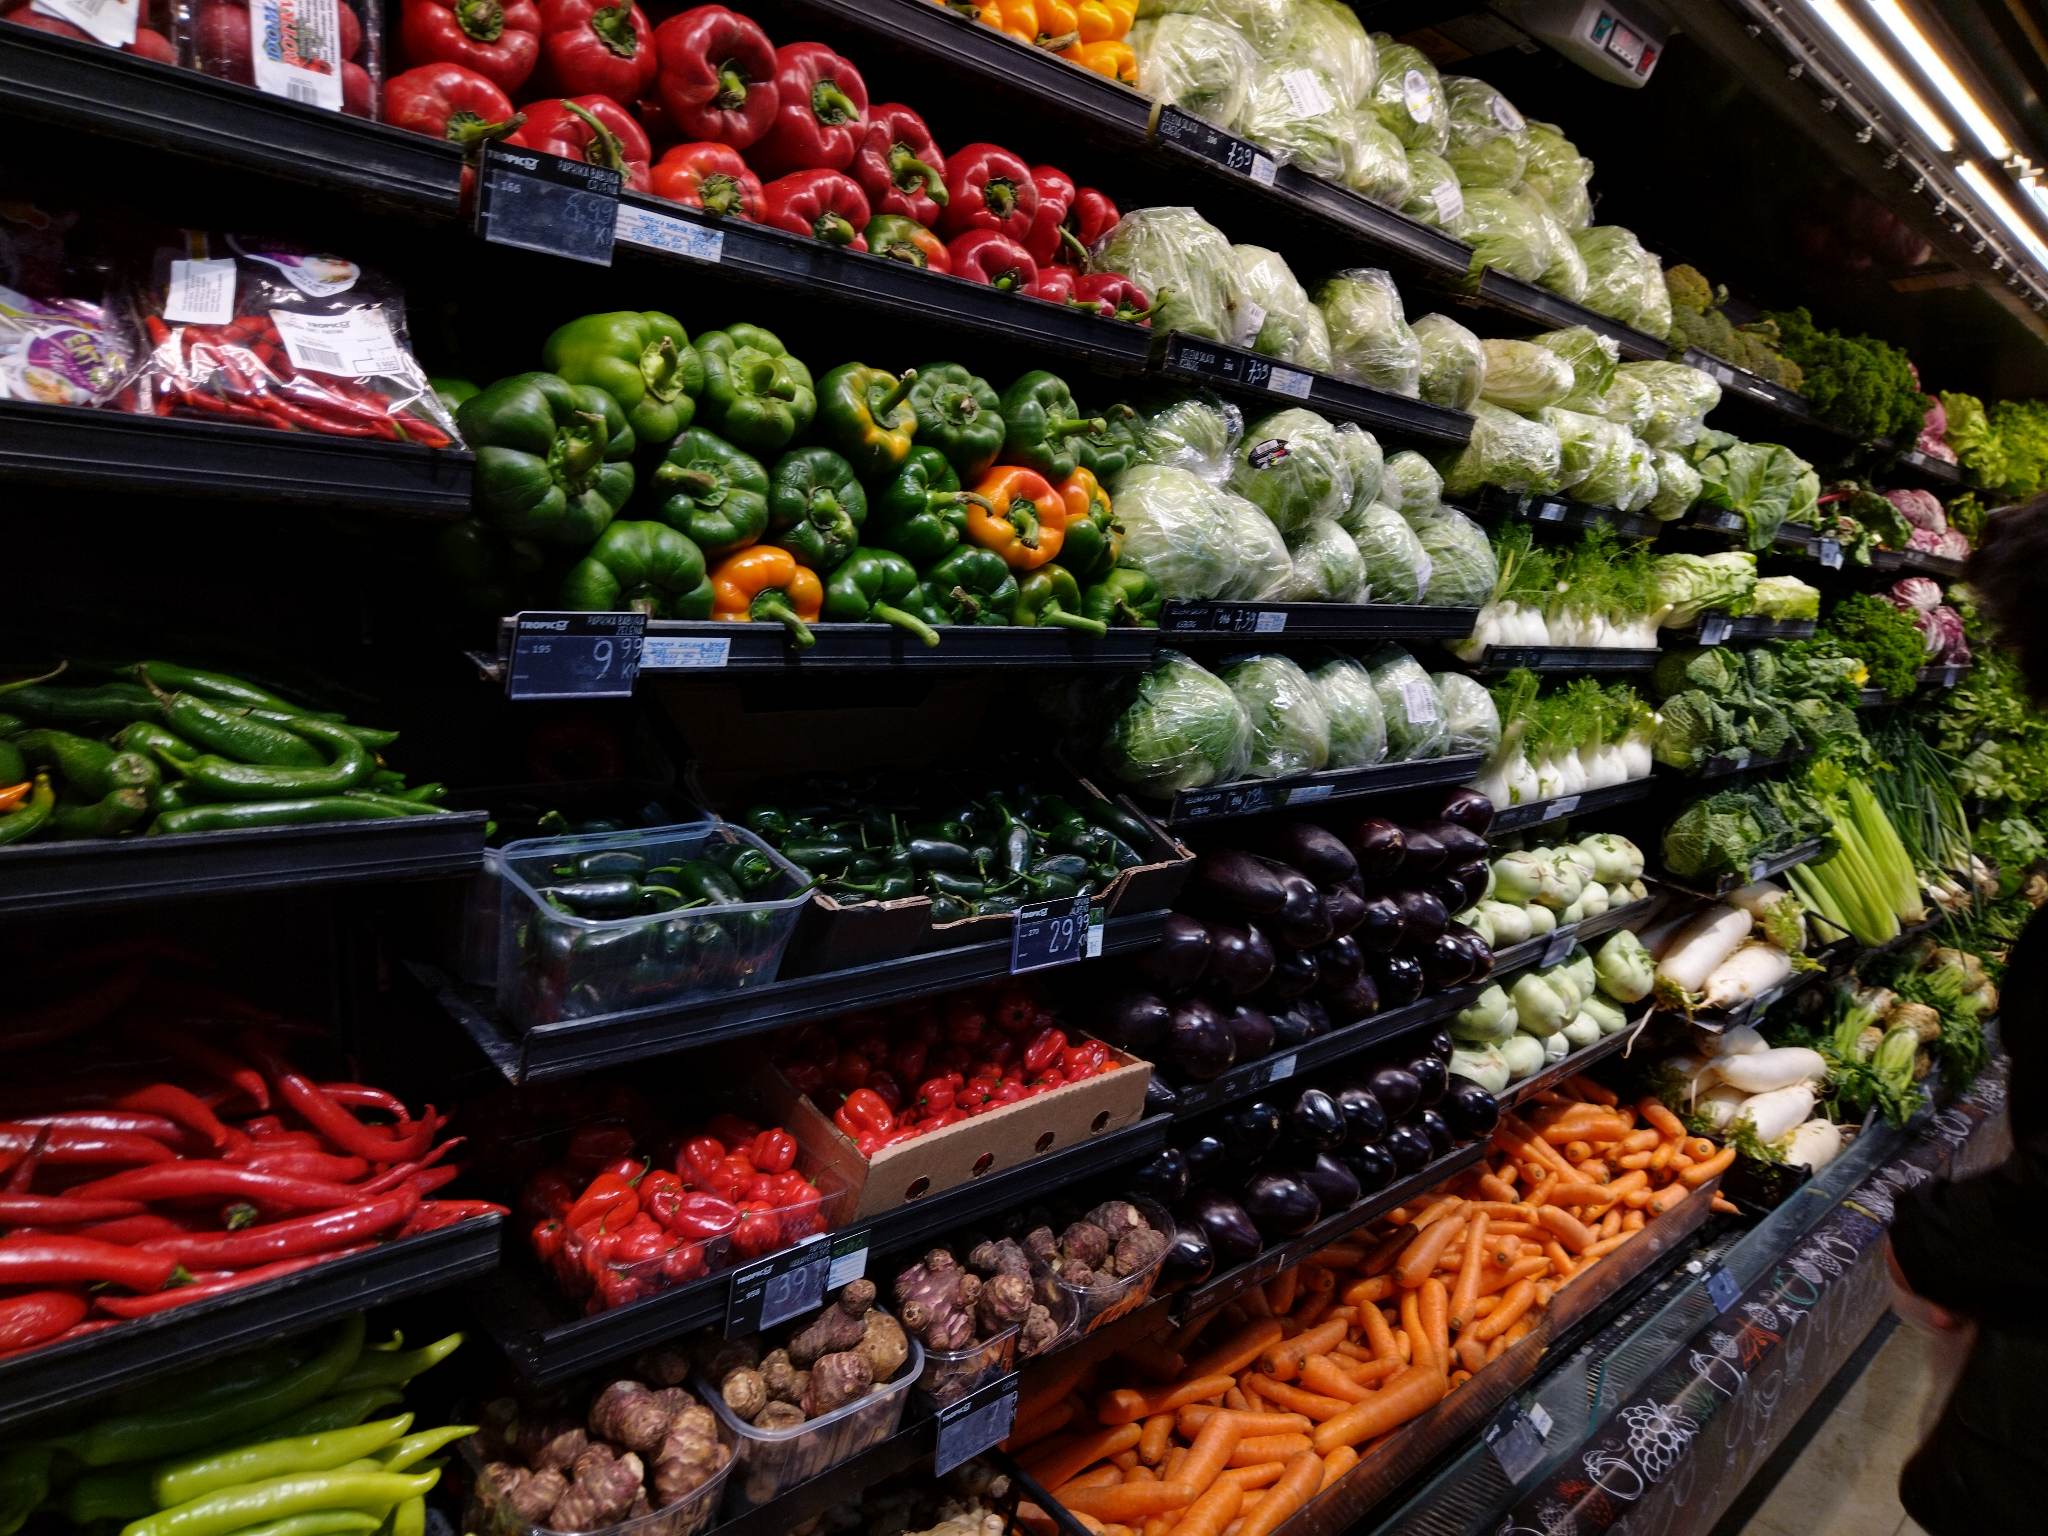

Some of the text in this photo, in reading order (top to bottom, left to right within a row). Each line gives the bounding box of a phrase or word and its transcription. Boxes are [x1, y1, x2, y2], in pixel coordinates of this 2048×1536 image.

[264, 0, 280, 60] DOM
[520, 620, 569, 630] TROPIC
[593, 639, 613, 680] 9
[621, 638, 643, 659] 99
[1049, 918, 1073, 953] 29
[1077, 914, 1090, 931] 99
[774, 1267, 808, 1304] 39
